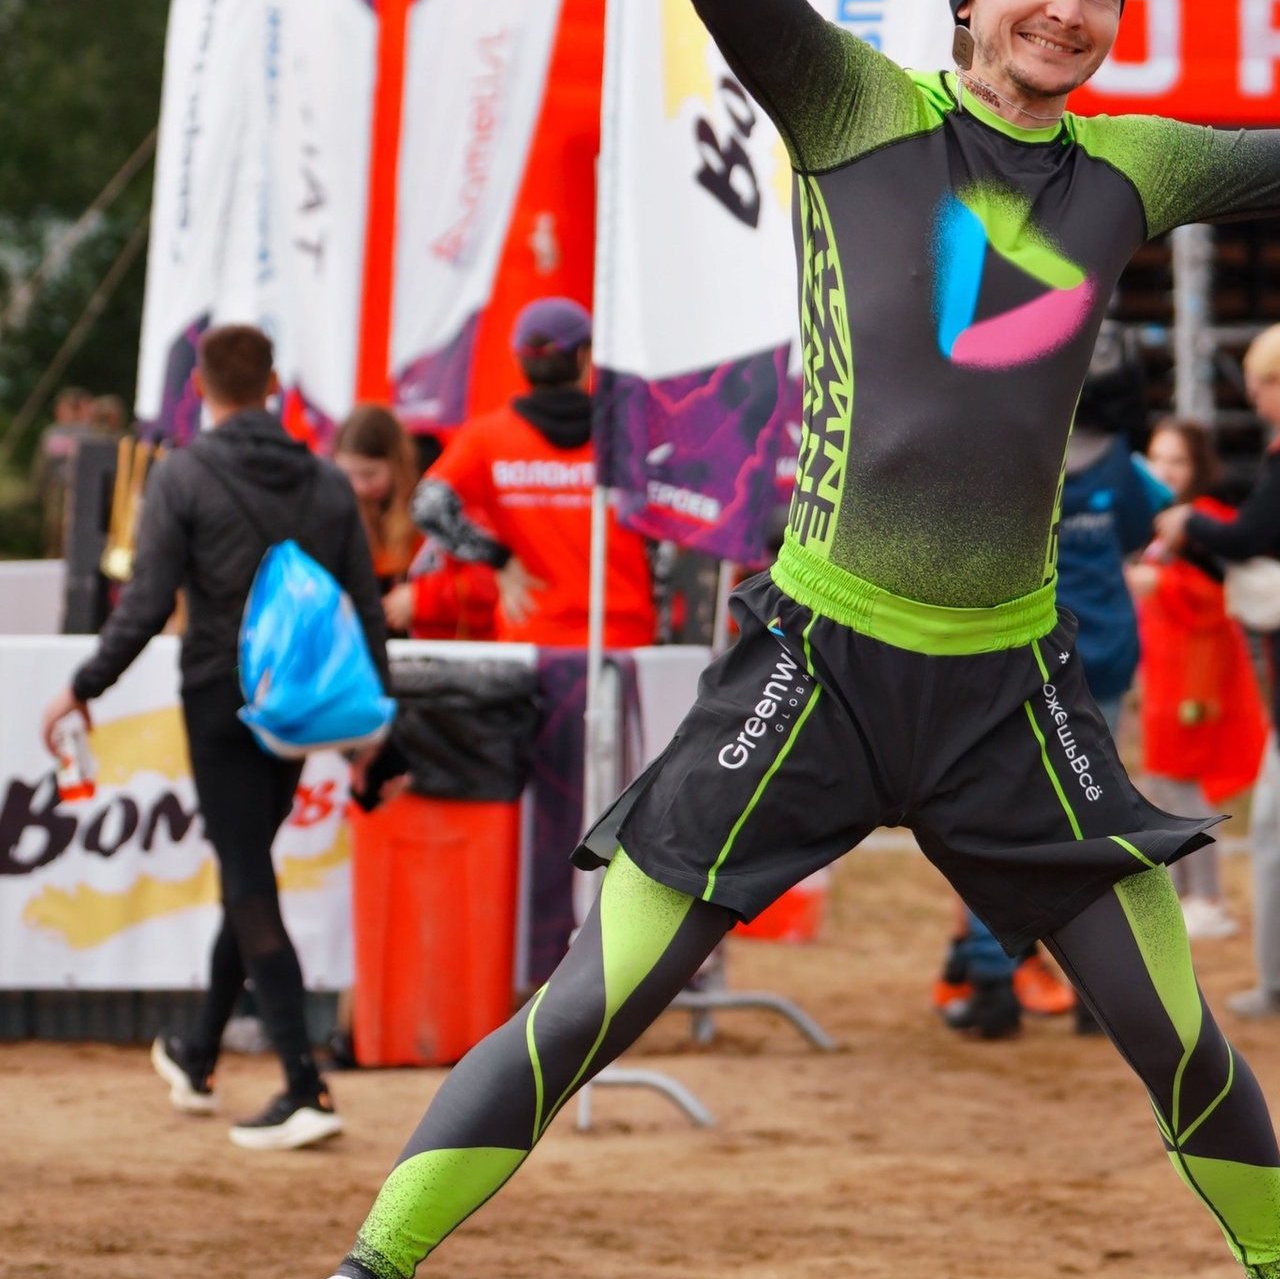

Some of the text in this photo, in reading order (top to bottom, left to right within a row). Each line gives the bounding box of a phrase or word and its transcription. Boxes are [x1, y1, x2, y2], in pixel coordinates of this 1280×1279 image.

[492, 459, 595, 488] ВОЛОНТ
[647, 479, 719, 521] ЕРОЕВ
[718, 651, 798, 770] Greenw
[775, 672, 811, 733] GLOBA
